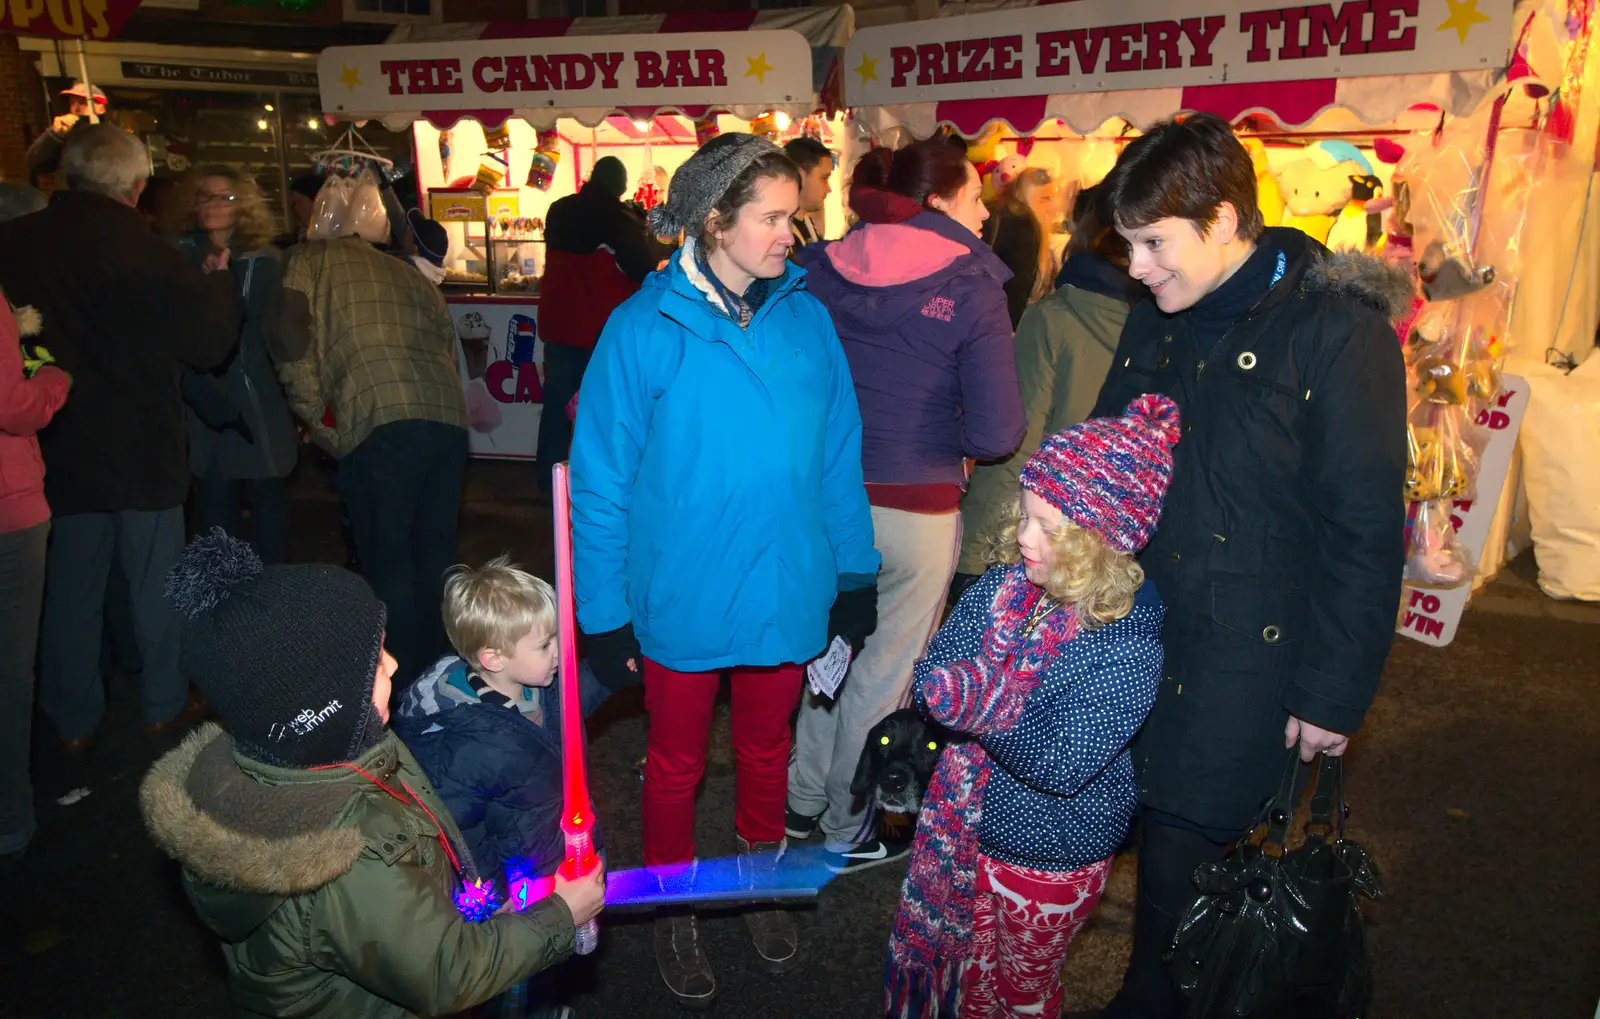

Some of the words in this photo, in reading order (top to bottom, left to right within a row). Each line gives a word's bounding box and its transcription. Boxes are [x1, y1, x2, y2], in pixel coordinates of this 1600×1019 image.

[0, 0, 109, 38] PUS
[890, 35, 1023, 88] PRIZE
[1035, 15, 1226, 77] EVERY
[1240, 0, 1419, 62] TIME
[136, 64, 181, 78] The
[190, 67, 252, 82] Tudor
[380, 58, 462, 95] THE
[472, 51, 624, 93] CANDY
[634, 48, 728, 88] BAR
[931, 296, 955, 309] UPER
[1411, 590, 1440, 614] TO
[287, 708, 315, 729] web
[294, 699, 343, 736] summit
